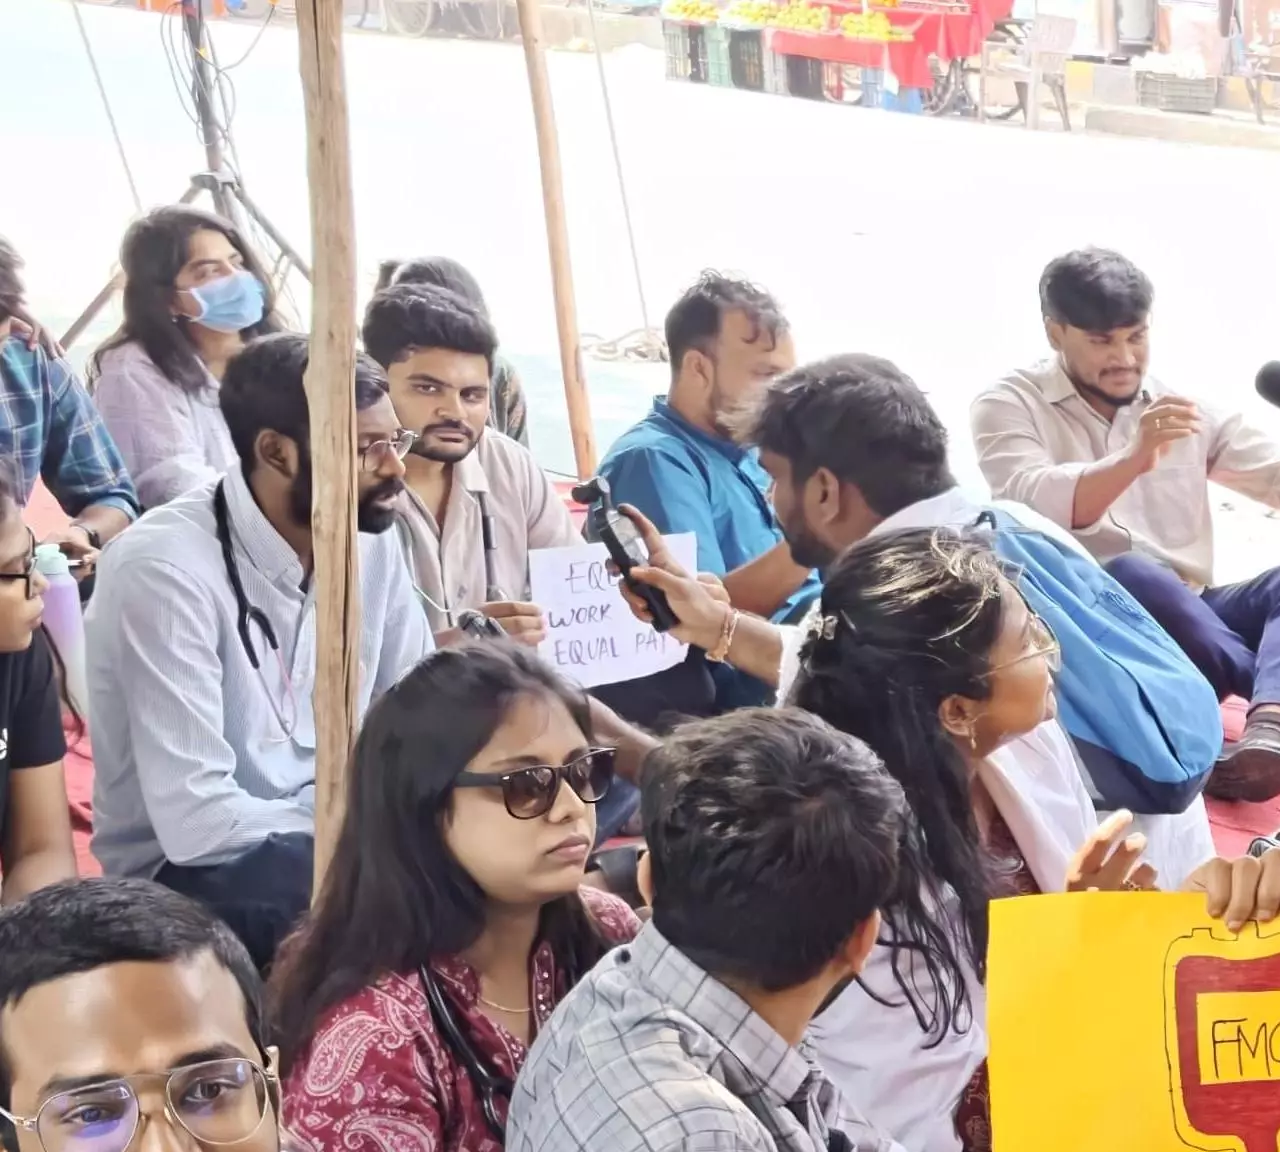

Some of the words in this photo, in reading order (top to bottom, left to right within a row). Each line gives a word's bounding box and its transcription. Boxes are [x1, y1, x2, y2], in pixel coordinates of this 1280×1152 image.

[549, 603, 613, 629] WORK
[554, 636, 620, 666] EQUAL
[635, 632, 668, 654] PAY
